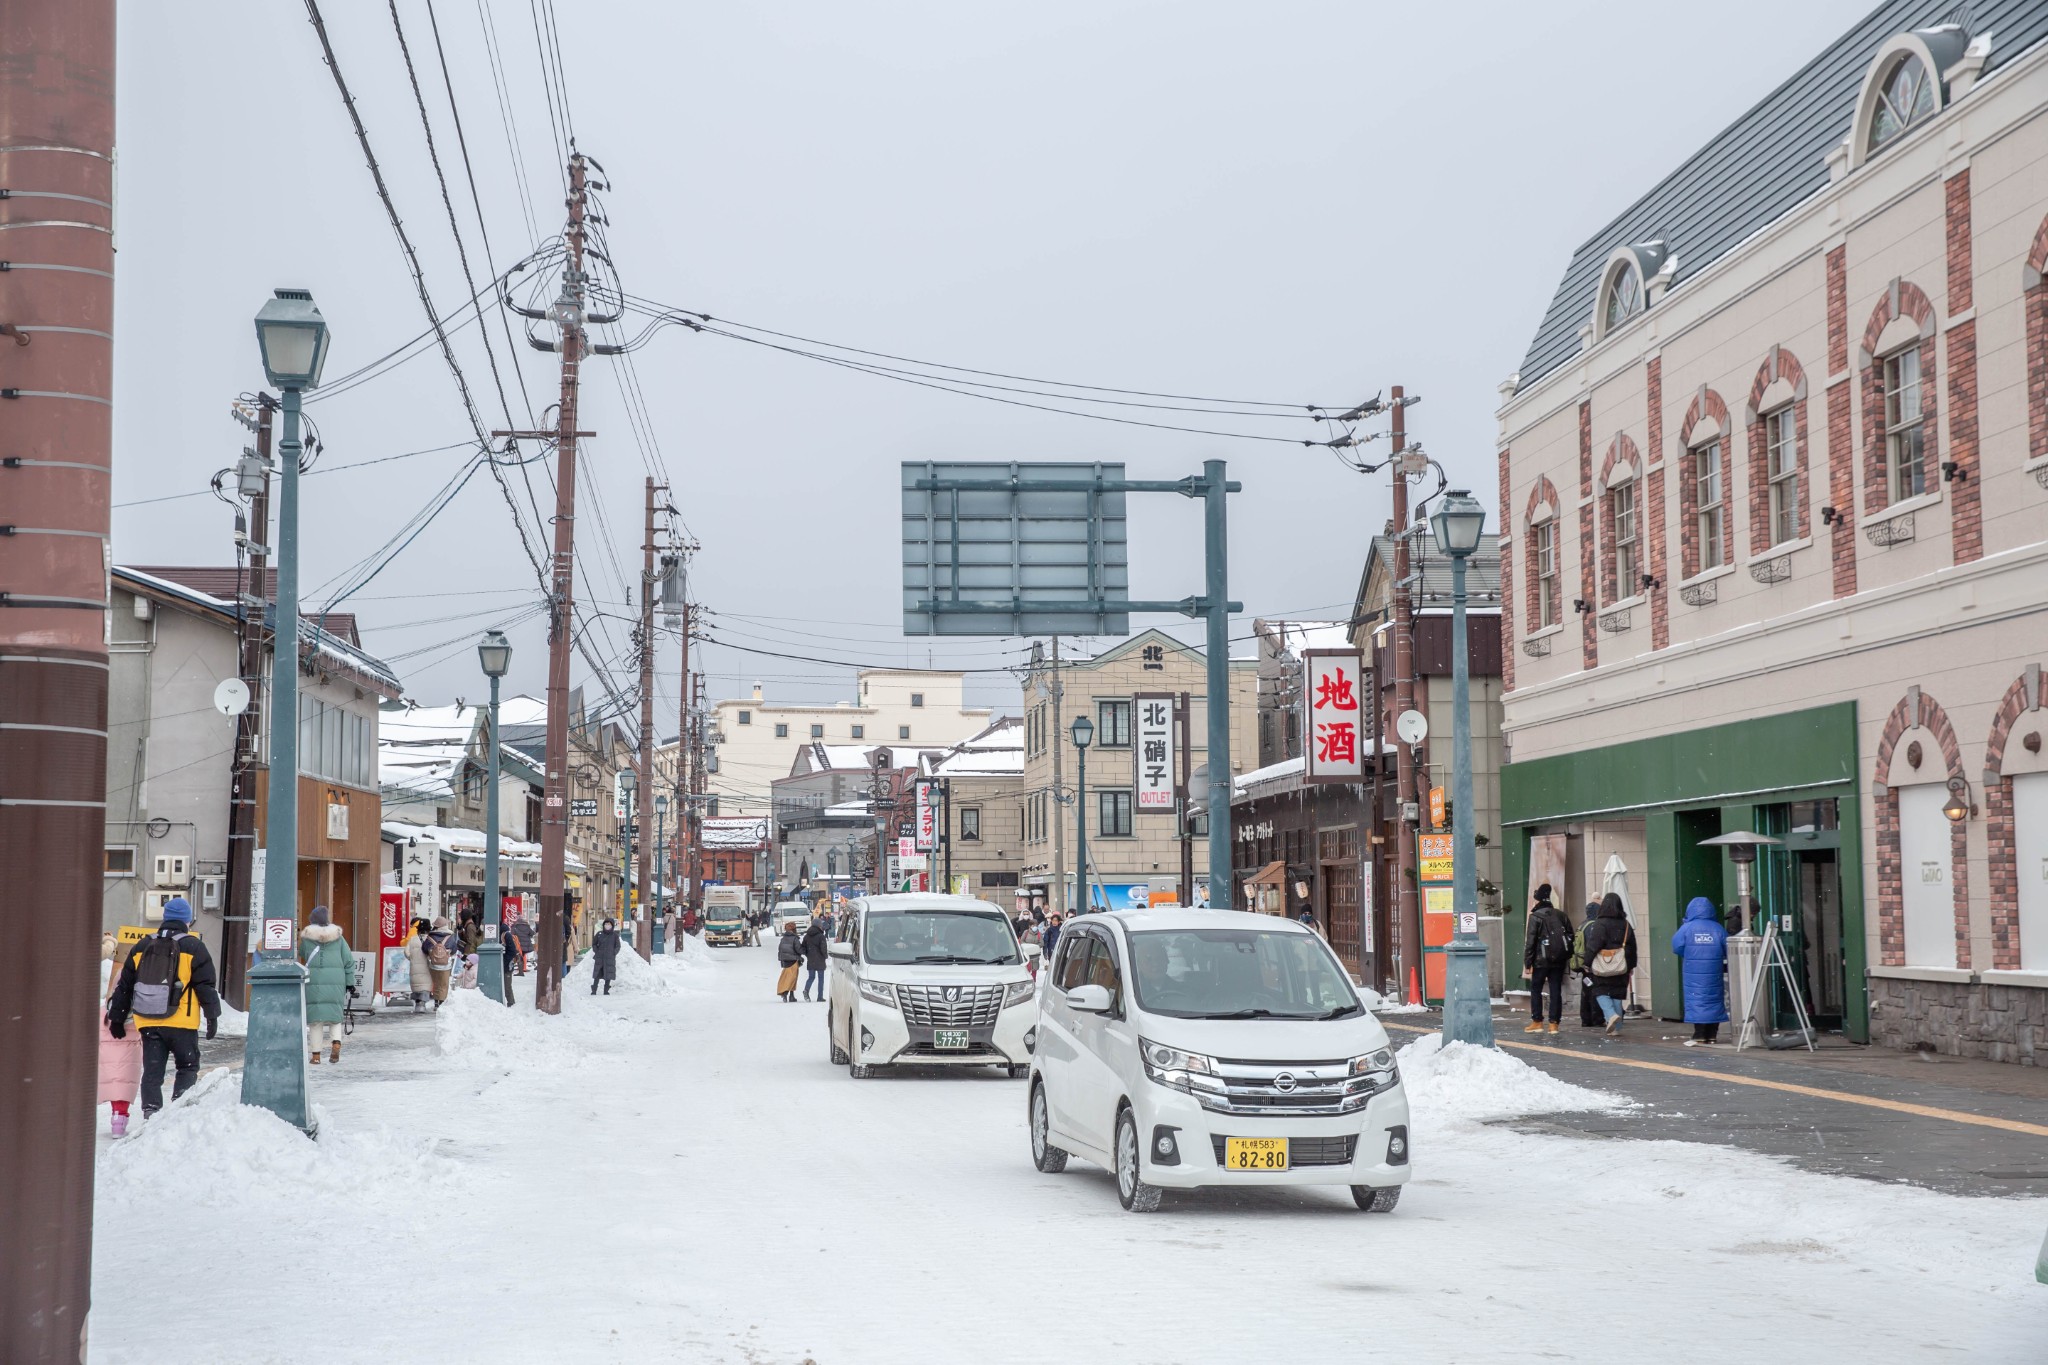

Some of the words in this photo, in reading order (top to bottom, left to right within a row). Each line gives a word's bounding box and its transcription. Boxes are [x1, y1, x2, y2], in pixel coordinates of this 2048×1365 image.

[1143, 645, 1163, 671] 北一
[1314, 667, 1358, 765] 地酒
[1143, 703, 1167, 787] 北一硝子
[1140, 791, 1171, 804] OUTLET
[1239, 1151, 1285, 1168] 82-80
